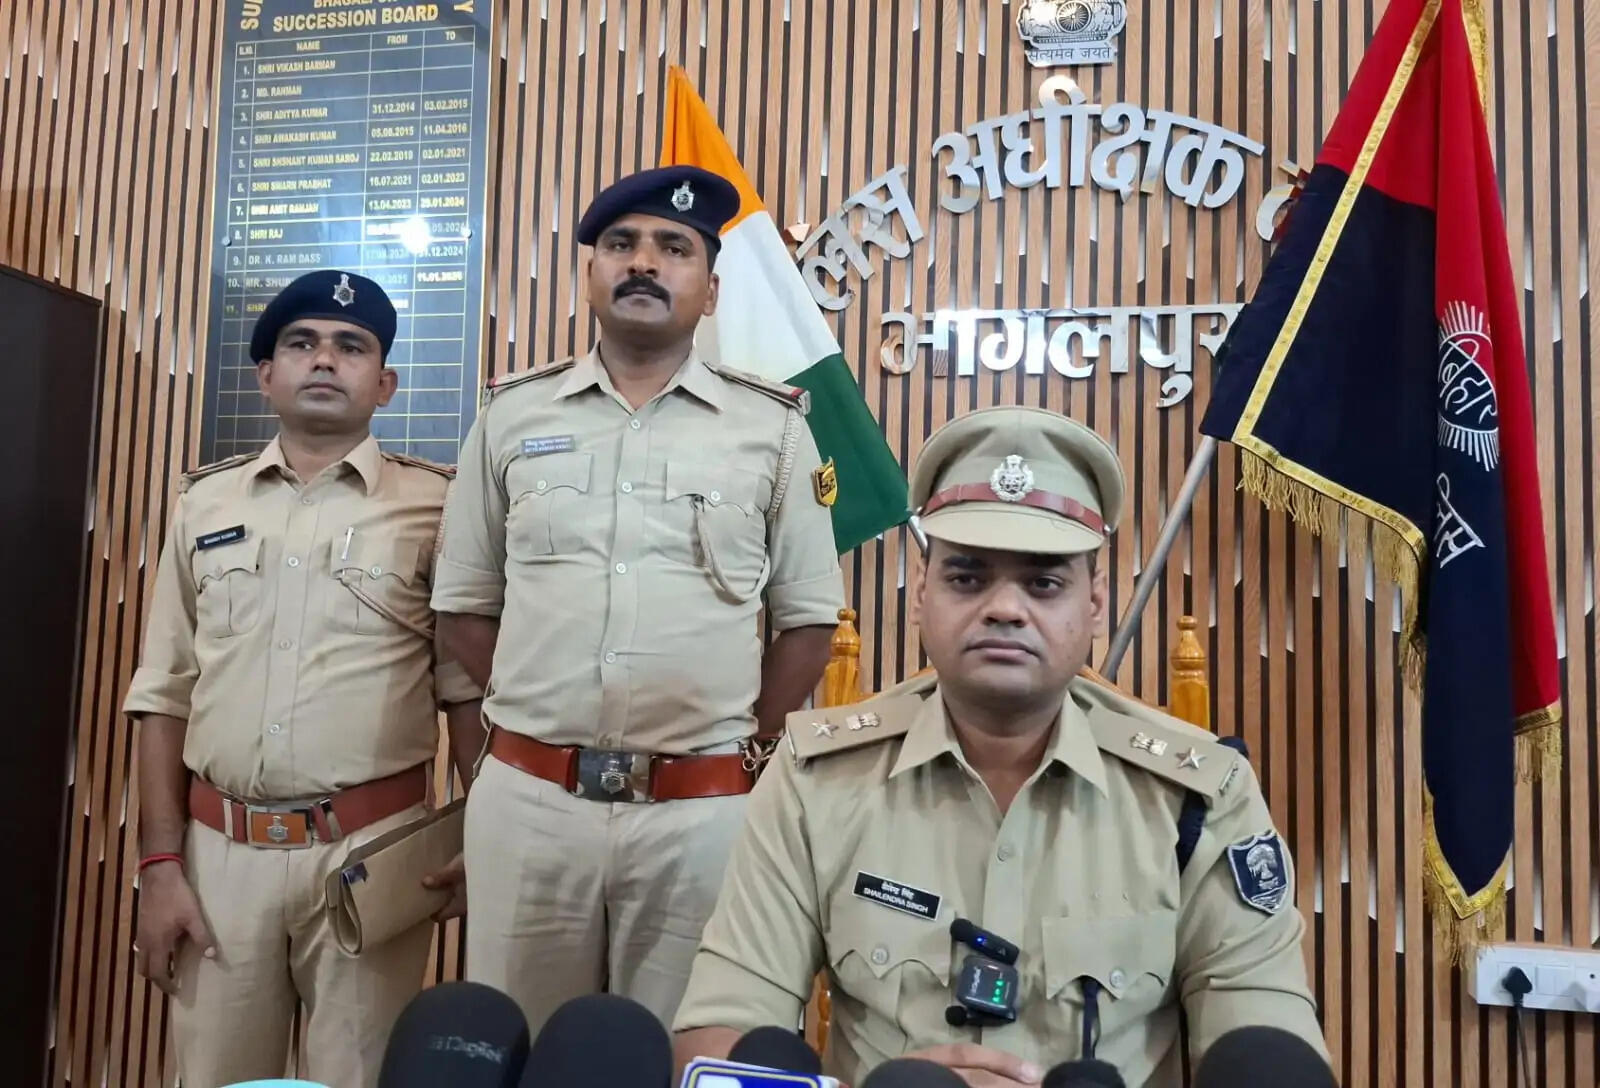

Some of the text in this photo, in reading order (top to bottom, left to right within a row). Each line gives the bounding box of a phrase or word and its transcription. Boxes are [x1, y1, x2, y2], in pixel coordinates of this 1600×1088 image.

[273, 4, 438, 32] SUCCESSION BOARD
[386, 34, 408, 45] FROM
[445, 31, 456, 40] TO
[1080, 43, 1111, 58] जयते
[257, 63, 274, 74] SHRI
[255, 110, 272, 121] SHRI
[273, 109, 300, 120] ADITYA
[301, 107, 328, 118] KUMAR
[372, 102, 415, 114] 31.12.2014
[235, 206, 244, 216] 7.
[250, 230, 267, 240] SHRI
[268, 228, 283, 239] RAJ
[232, 255, 241, 266] 9.
[227, 277, 241, 288] 10.
[906, 900, 929, 914] SINGH
